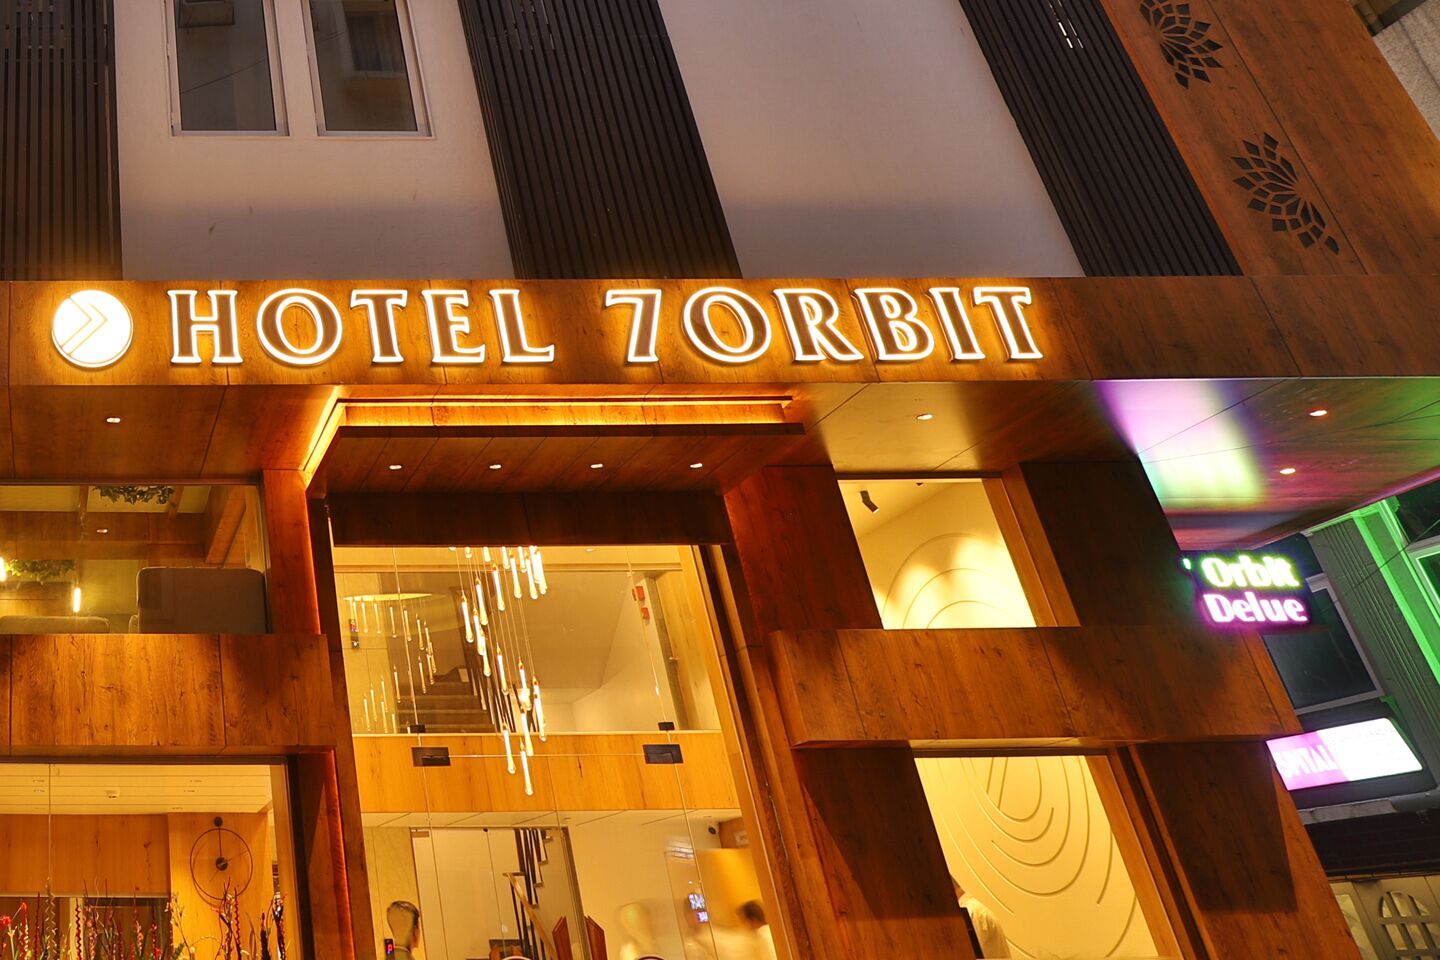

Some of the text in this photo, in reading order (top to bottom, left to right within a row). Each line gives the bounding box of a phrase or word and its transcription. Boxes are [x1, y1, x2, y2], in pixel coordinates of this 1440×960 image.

[166, 285, 1043, 365] HOTEL 7 ORBIT
[1200, 553, 1300, 588] Orbit
[1202, 590, 1309, 623] Delue
